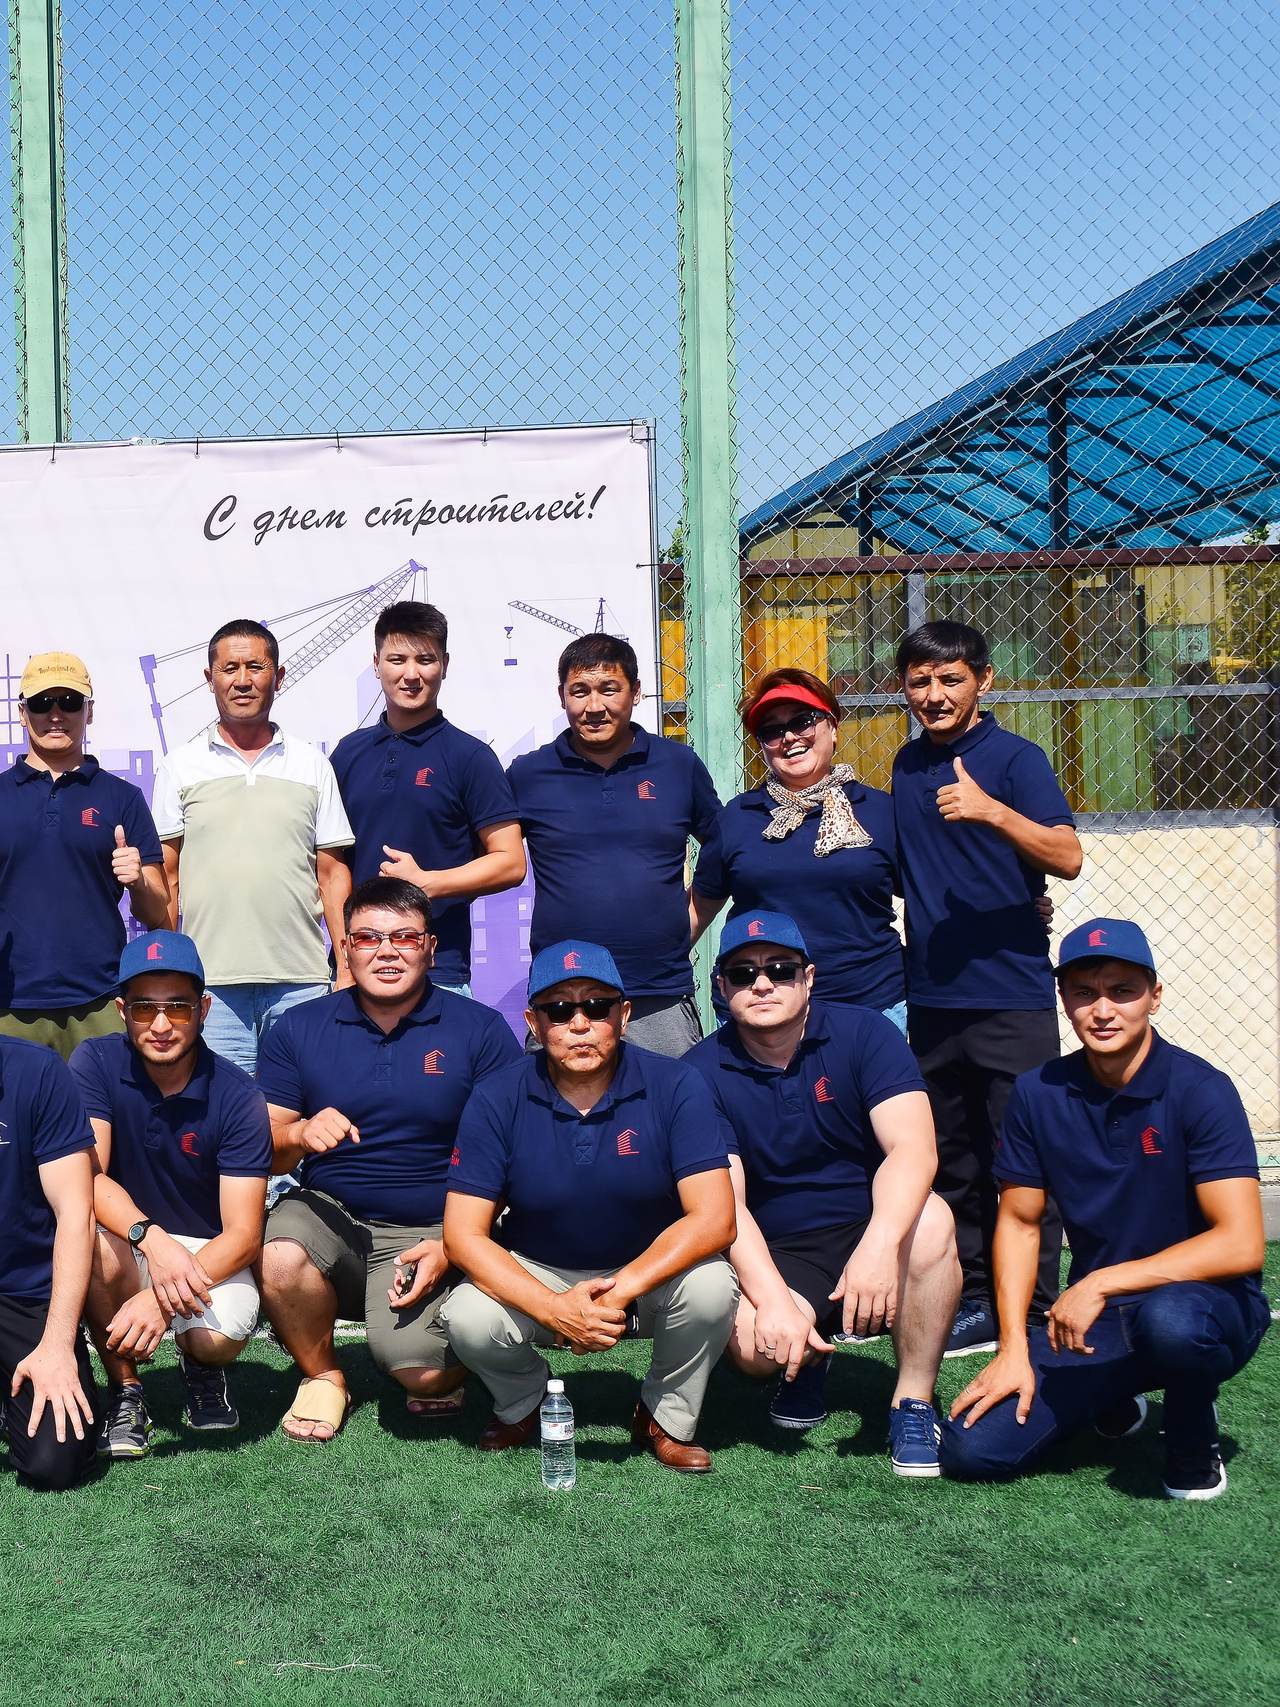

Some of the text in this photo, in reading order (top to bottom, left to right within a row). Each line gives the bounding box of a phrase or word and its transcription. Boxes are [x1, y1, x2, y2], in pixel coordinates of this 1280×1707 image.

[203, 485, 607, 547] С днем строителей!
